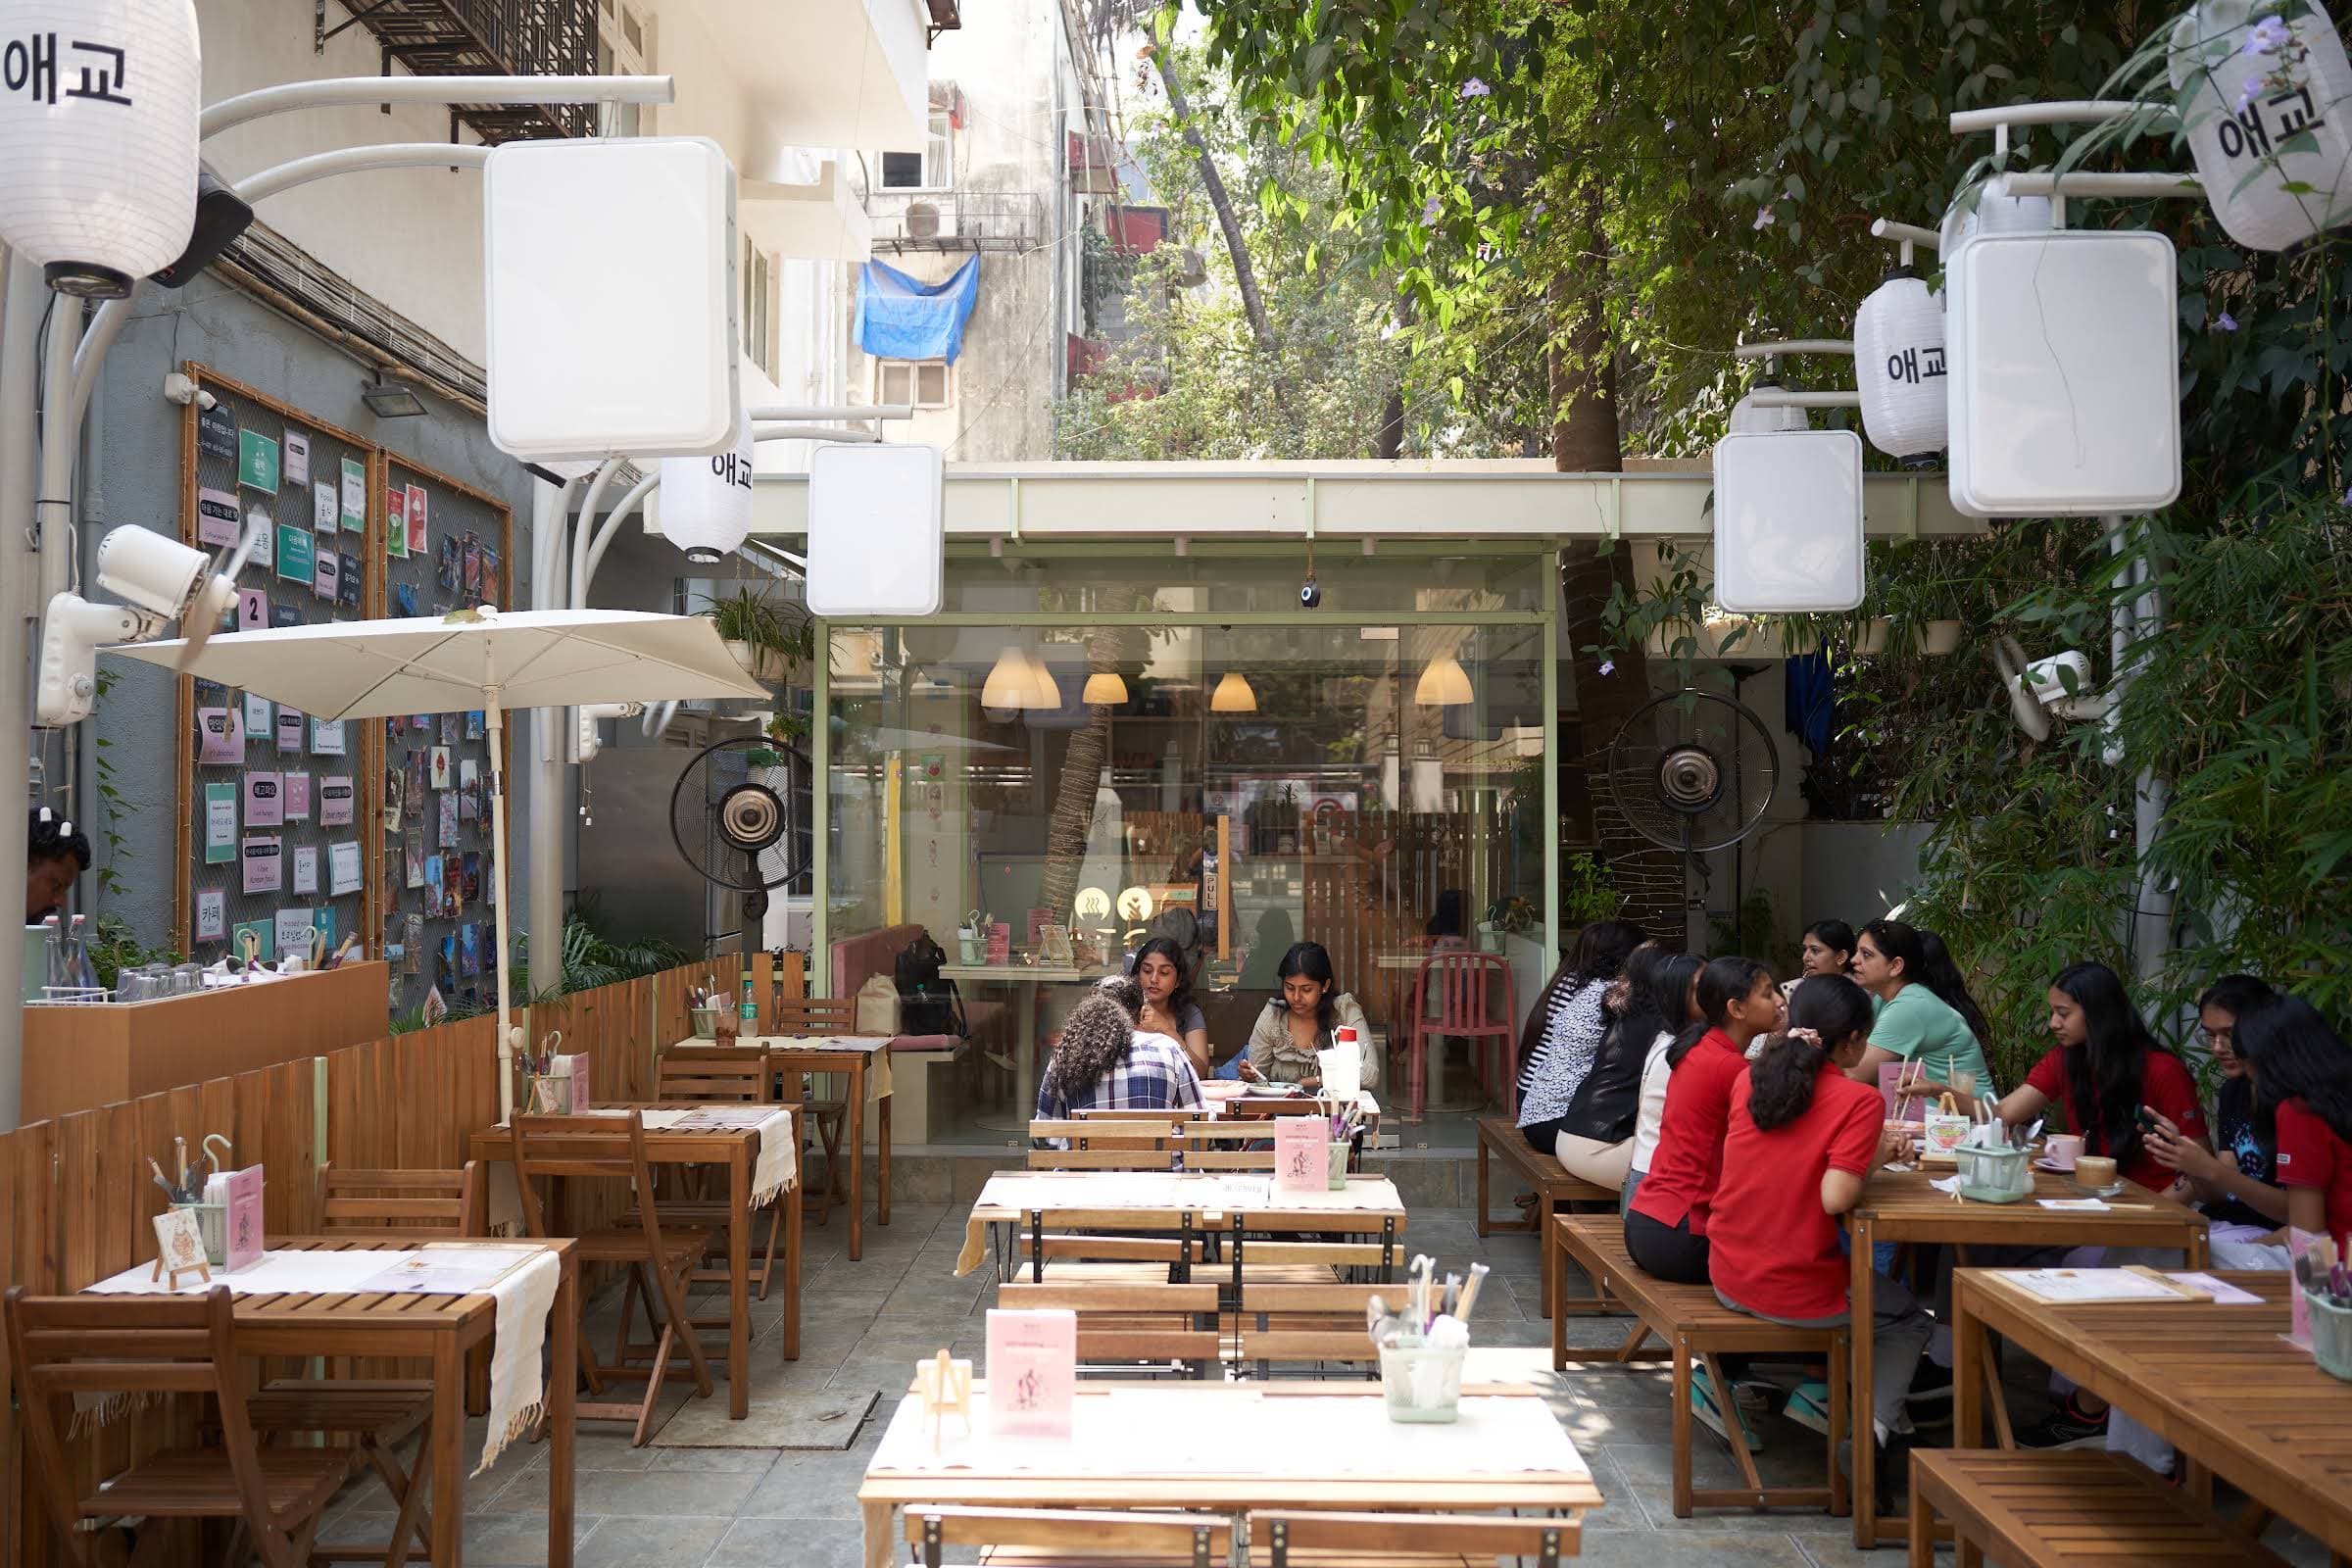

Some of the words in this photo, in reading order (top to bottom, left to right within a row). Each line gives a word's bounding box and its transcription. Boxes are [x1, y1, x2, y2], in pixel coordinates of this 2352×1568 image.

[4, 32, 132, 107] 애교
[2218, 86, 2326, 158] 애교
[1887, 347, 1947, 384] 애교
[711, 452, 752, 490] 애교
[249, 596, 259, 621] 2
[1206, 877, 1215, 908] PULL
[202, 905, 220, 922] 카페
